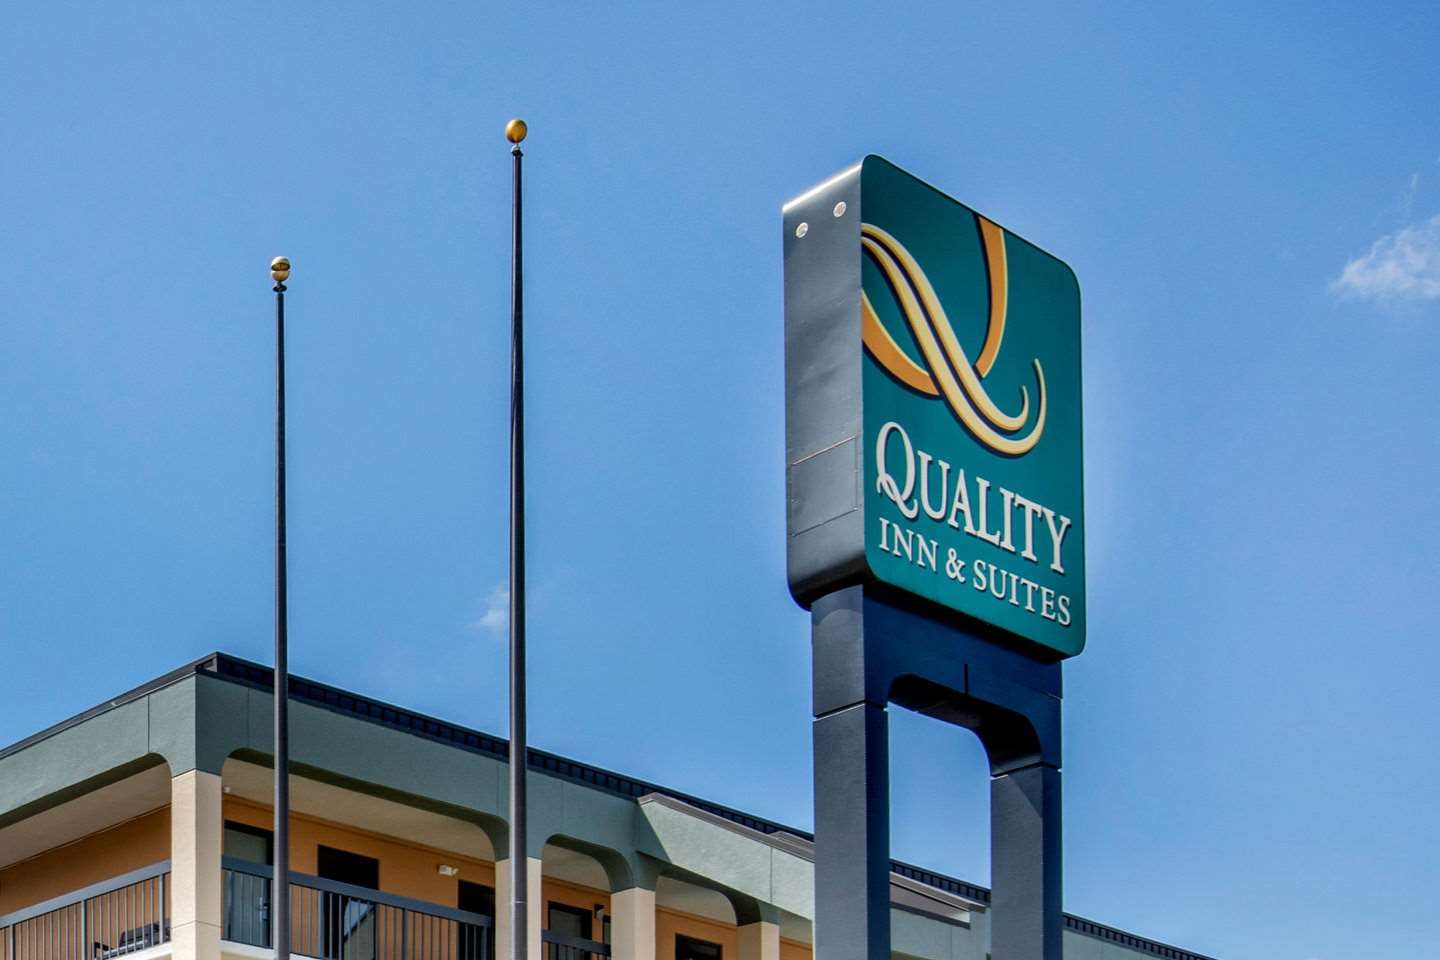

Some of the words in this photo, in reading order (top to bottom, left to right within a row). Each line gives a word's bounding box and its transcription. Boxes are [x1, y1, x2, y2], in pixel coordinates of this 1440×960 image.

[876, 421, 1071, 574] QUALITY
[879, 517, 938, 573] INN
[945, 547, 966, 583] &
[973, 559, 1071, 626] SUITES
